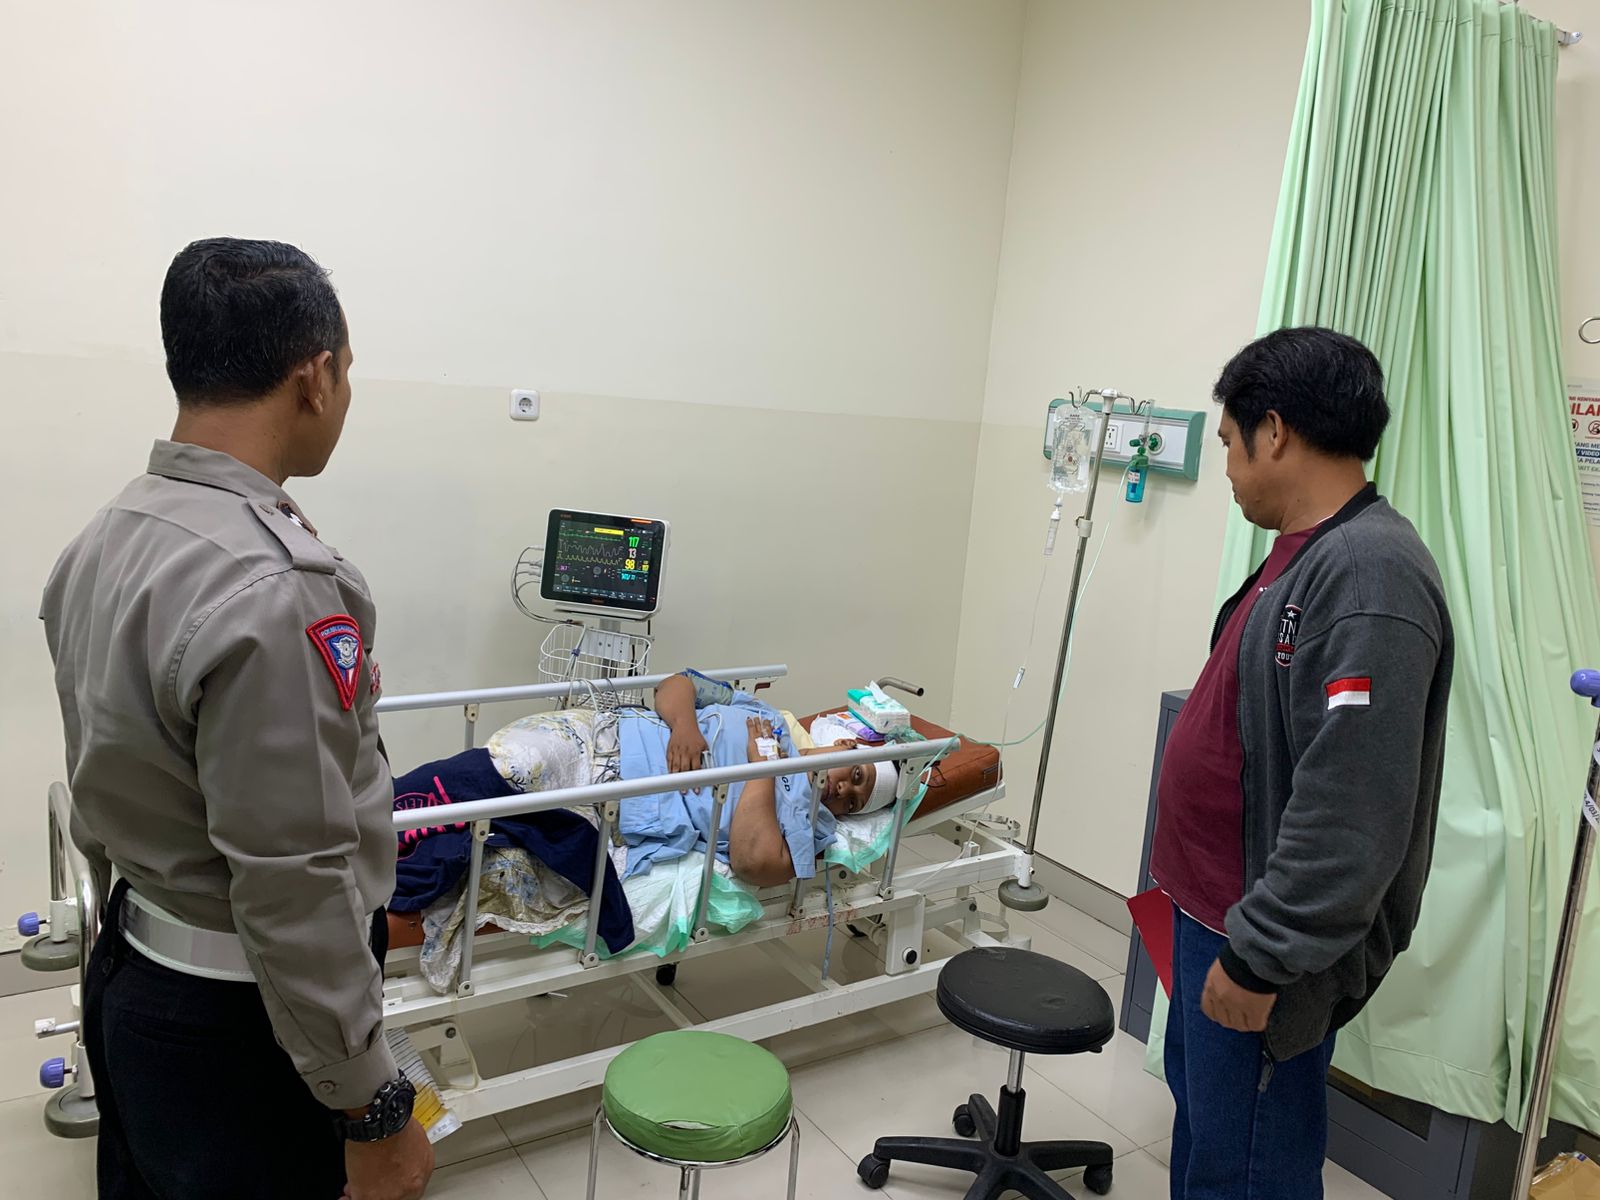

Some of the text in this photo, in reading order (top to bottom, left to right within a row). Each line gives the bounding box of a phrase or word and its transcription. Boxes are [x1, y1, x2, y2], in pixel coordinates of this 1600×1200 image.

[629, 537, 640, 547] 117
[628, 548, 637, 558] 13
[782, 777, 790, 791] GD
